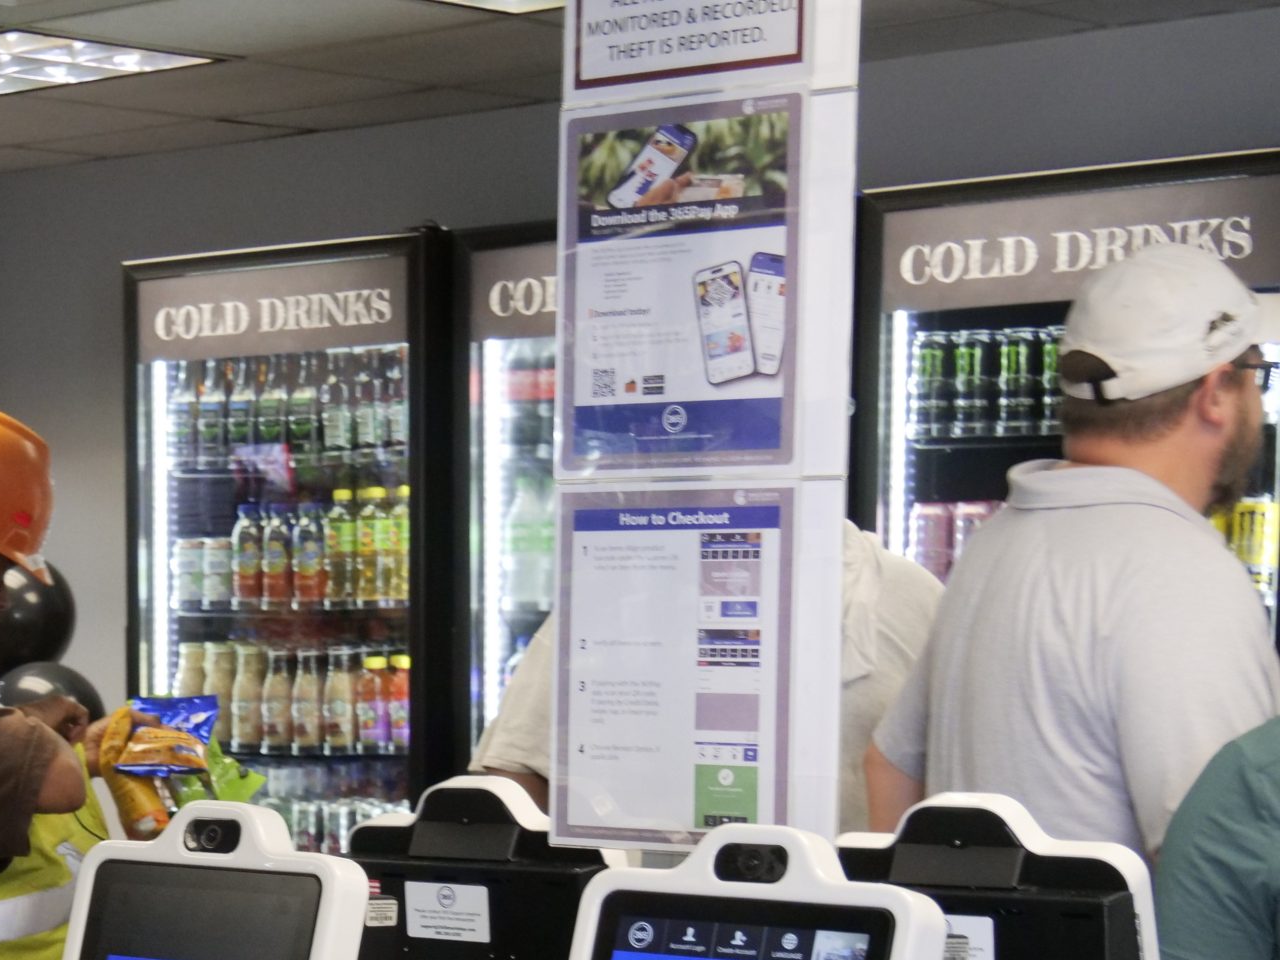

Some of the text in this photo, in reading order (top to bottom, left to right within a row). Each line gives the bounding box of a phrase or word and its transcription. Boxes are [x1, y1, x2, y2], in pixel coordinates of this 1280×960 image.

[587, 10, 681, 37] MONITORED
[687, 8, 698, 23] &
[608, 26, 767, 61] THEFT IS REPORTED.
[591, 210, 647, 227] Download
[648, 209, 668, 221] the
[714, 203, 739, 218] App
[900, 235, 1039, 285] COLD
[489, 276, 558, 317] COL
[154, 288, 392, 341] COLD DRINKS
[619, 511, 730, 526] How to Checkout
